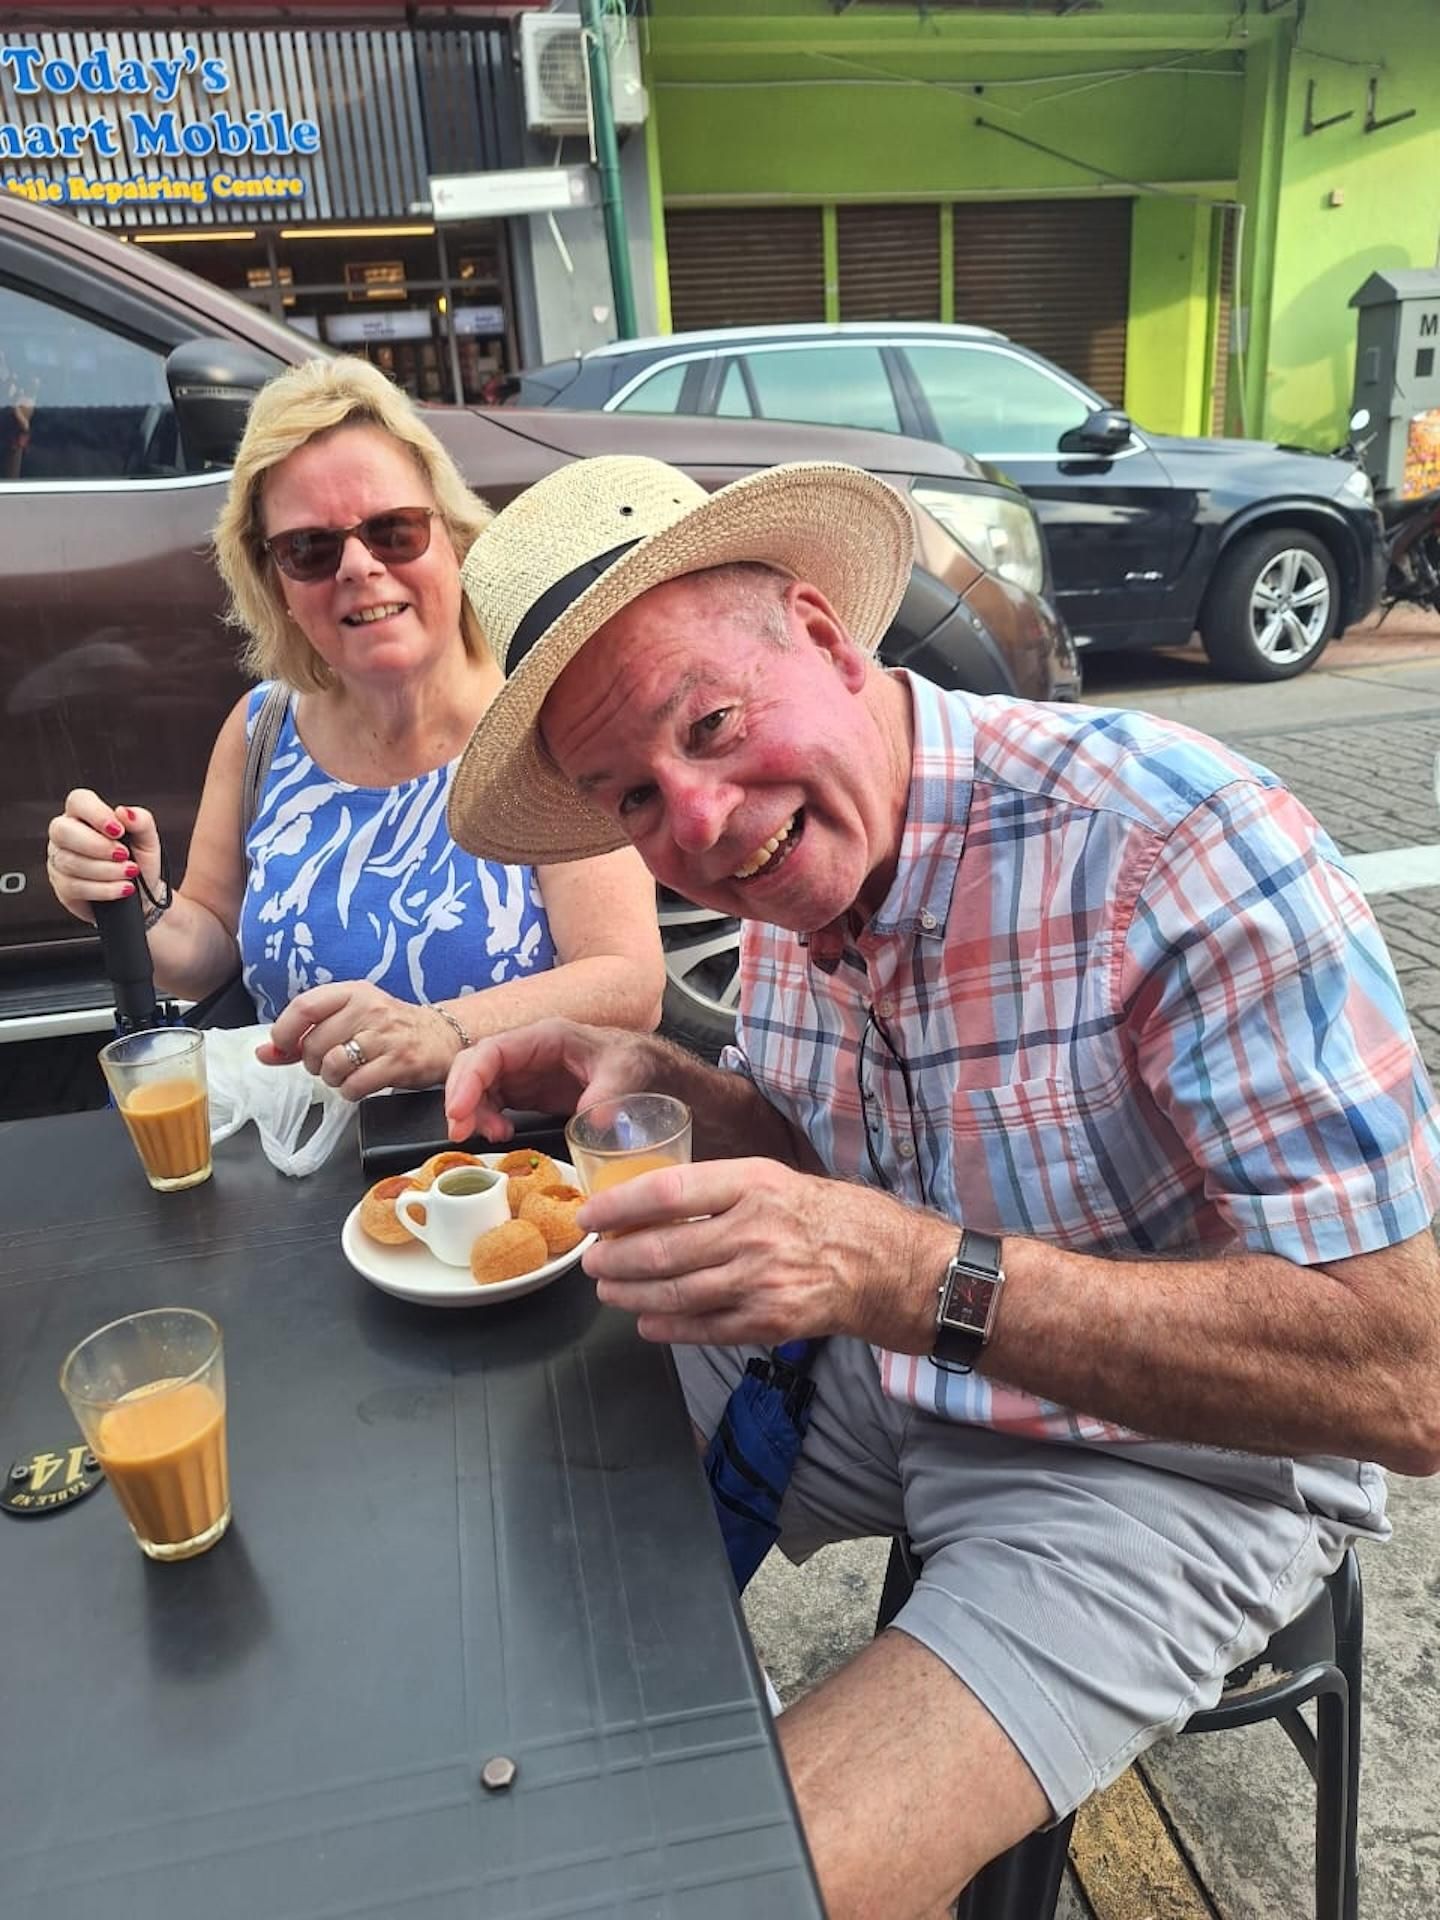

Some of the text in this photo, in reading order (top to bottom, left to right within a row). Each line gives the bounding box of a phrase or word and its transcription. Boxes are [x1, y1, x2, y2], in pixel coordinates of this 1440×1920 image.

[2, 47, 229, 101] Today's
[129, 112, 320, 156] Mobile
[67, 174, 207, 204] Repairing
[211, 173, 305, 199] Centre
[29, 1445, 88, 1491] 14
[36, 1481, 91, 1506] TABLE
